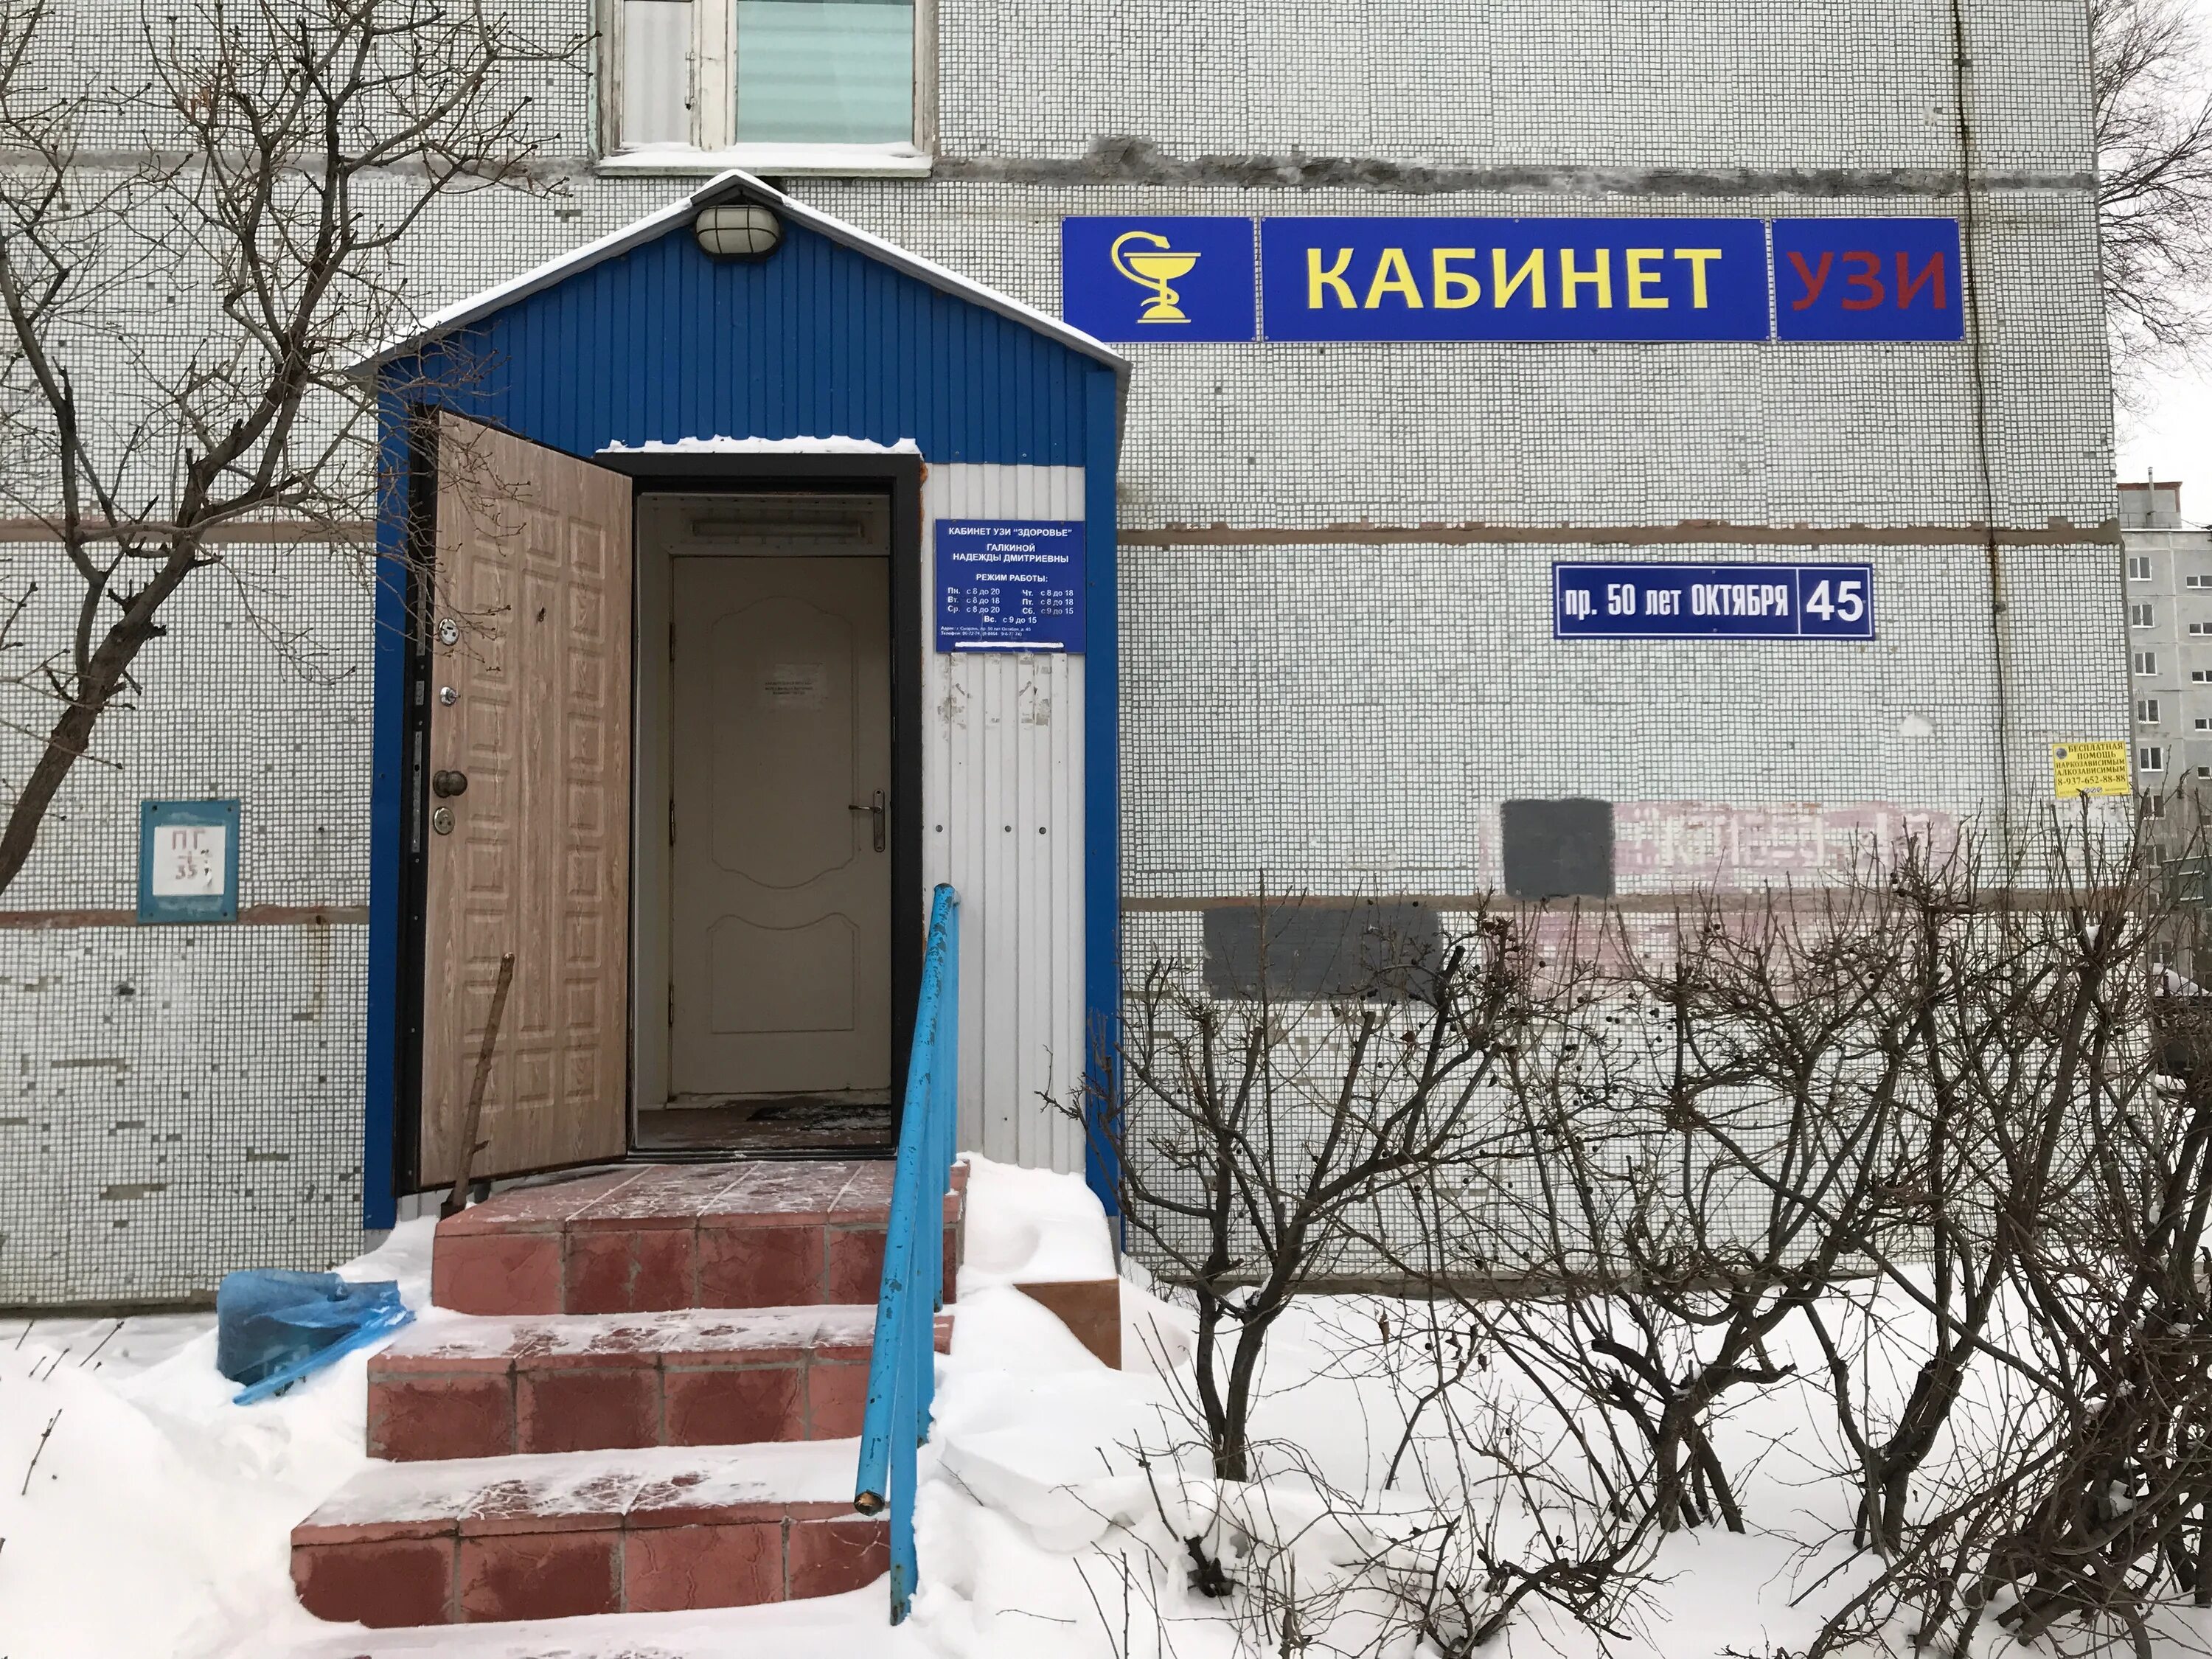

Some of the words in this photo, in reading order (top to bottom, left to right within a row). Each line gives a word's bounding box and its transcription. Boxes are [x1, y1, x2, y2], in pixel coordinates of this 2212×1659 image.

[1307, 247, 1722, 310] КАБИНЕТ
[1787, 251, 1950, 311] УЗИ
[987, 543, 1035, 552] ГАЛКИНОЙ
[953, 554, 1001, 562] НАДЕЖДЫ
[1004, 554, 1068, 563] ДМИТРИЕВНЫ
[976, 574, 1007, 582] РЕЖИМ
[1565, 589, 1598, 620] пр.
[1607, 584, 1635, 615] 50
[1646, 589, 1682, 616] лет
[1691, 584, 1788, 616] ОКТЯБРЯ
[1806, 580, 1864, 622] 45
[948, 606, 960, 614] Ср.
[2068, 743, 2123, 752] БЕСПЛАТНАЯ
[2077, 751, 2116, 759] ПОМОЩЬ
[2056, 759, 2125, 768] НАРКОЗАВИСИМЫМ
[2057, 766, 2126, 776] АЛКОЗАВИСИМЫМ
[2058, 774, 2126, 786] 8-937-652-88-88
